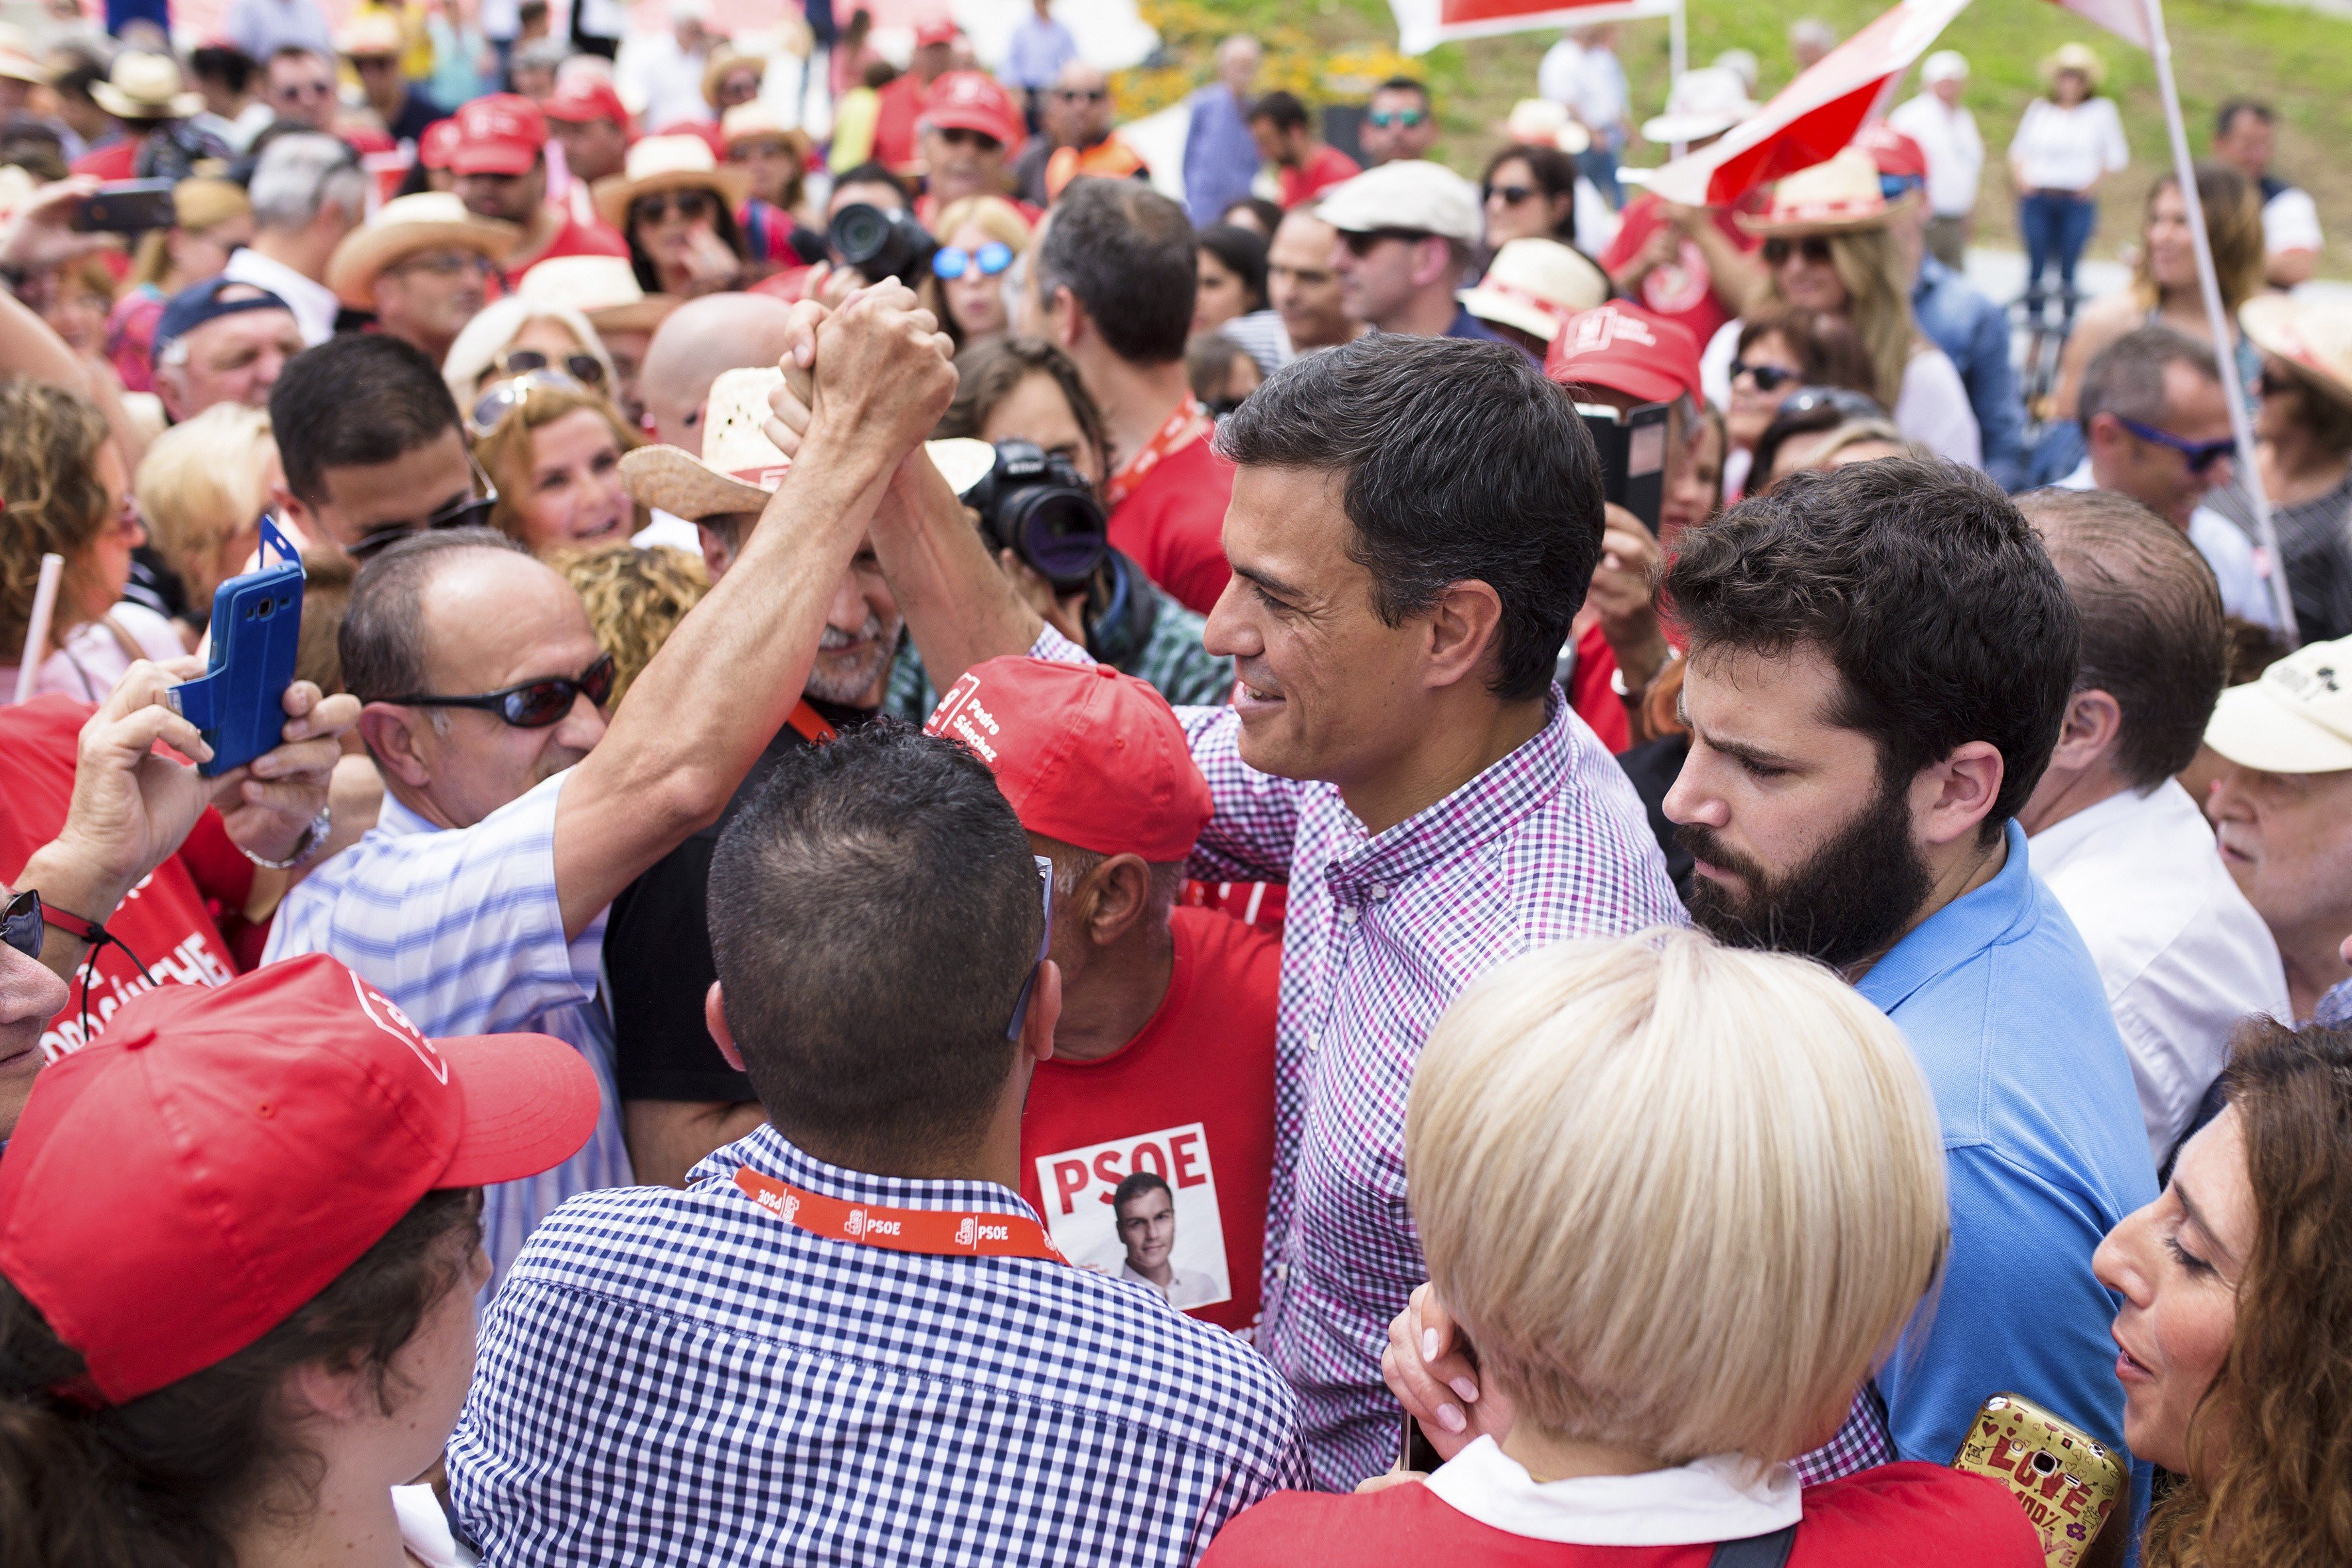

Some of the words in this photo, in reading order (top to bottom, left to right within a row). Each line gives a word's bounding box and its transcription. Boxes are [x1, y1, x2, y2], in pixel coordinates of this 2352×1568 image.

[967, 698, 1000, 735] Pedro
[953, 714, 997, 762] Sánchez
[1054, 1133, 1207, 1215] PSOE
[757, 1189, 783, 1210] PSOE
[867, 1219, 901, 1235] PSOE
[978, 1225, 1008, 1240] PSOE
[1988, 1435, 2093, 1518] LOVE
